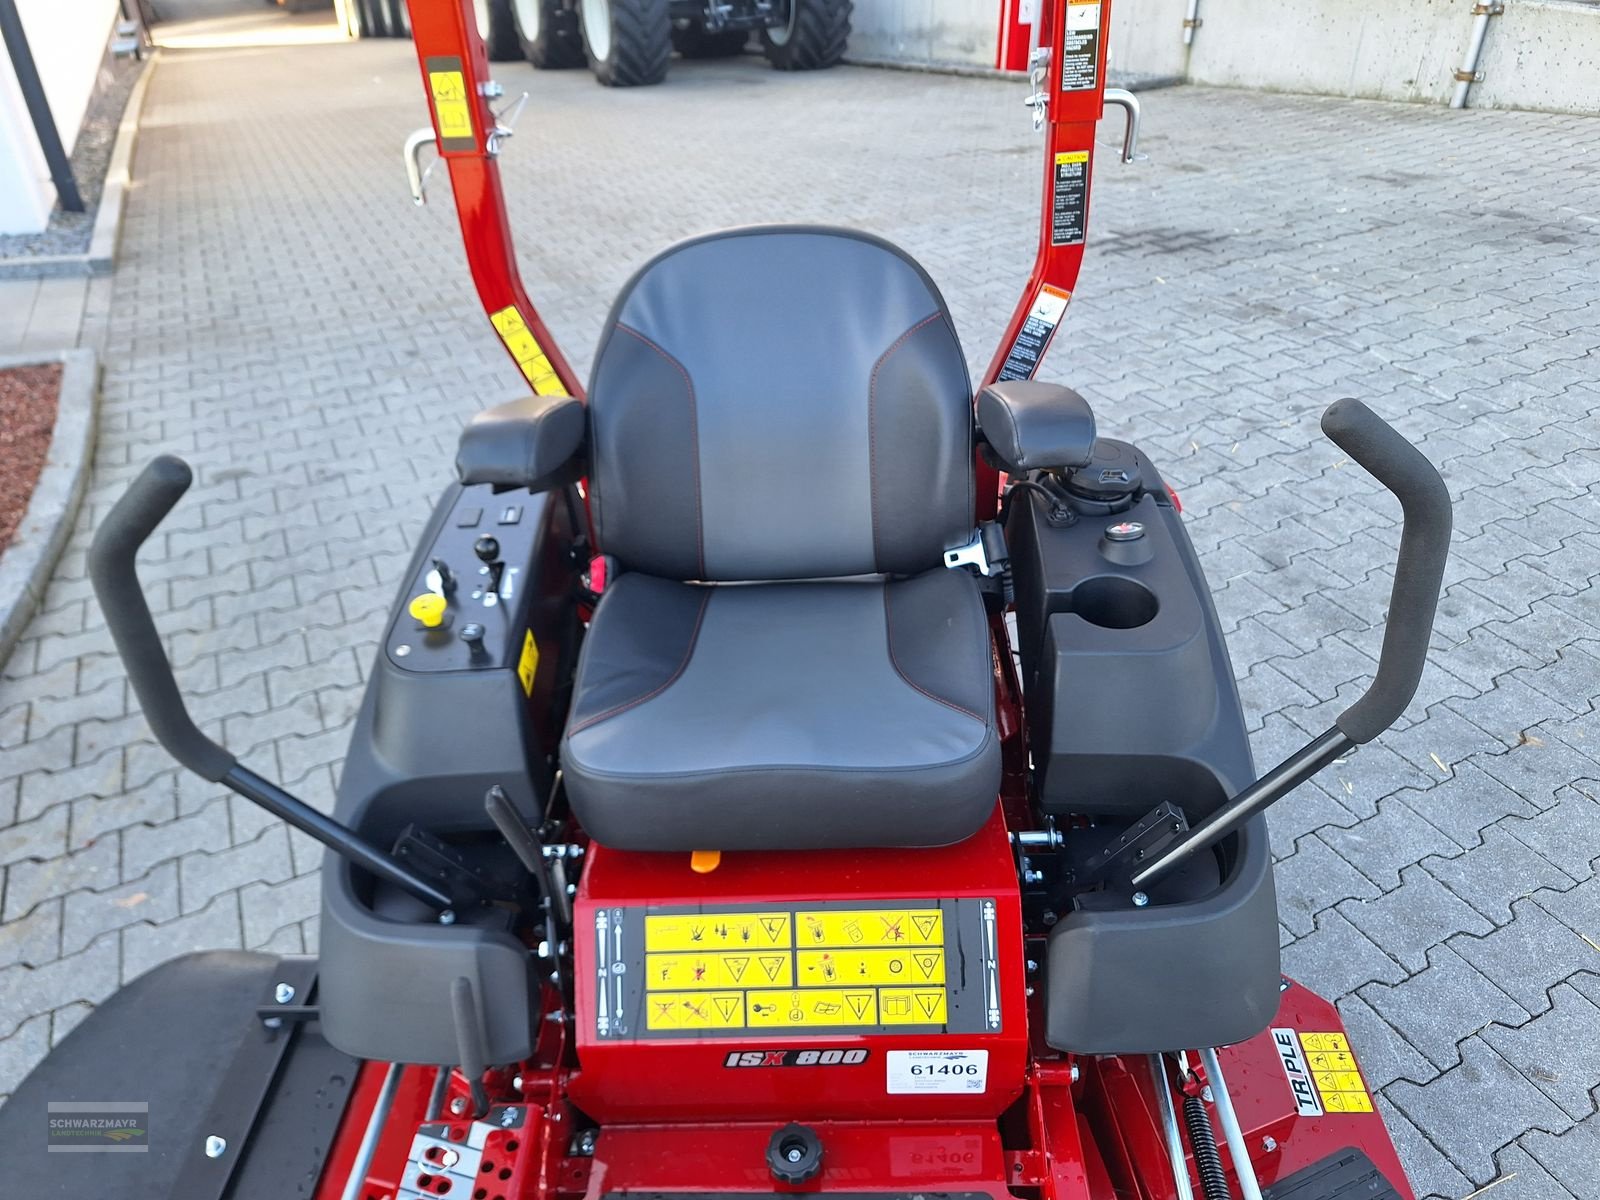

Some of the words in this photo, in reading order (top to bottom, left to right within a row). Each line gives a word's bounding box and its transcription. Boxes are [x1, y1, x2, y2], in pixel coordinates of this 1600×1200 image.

[725, 1051, 787, 1067] ISX
[795, 1049, 868, 1065] 800
[911, 1064, 978, 1076] 61406
[1275, 1033, 1313, 1108] TRIPLE
